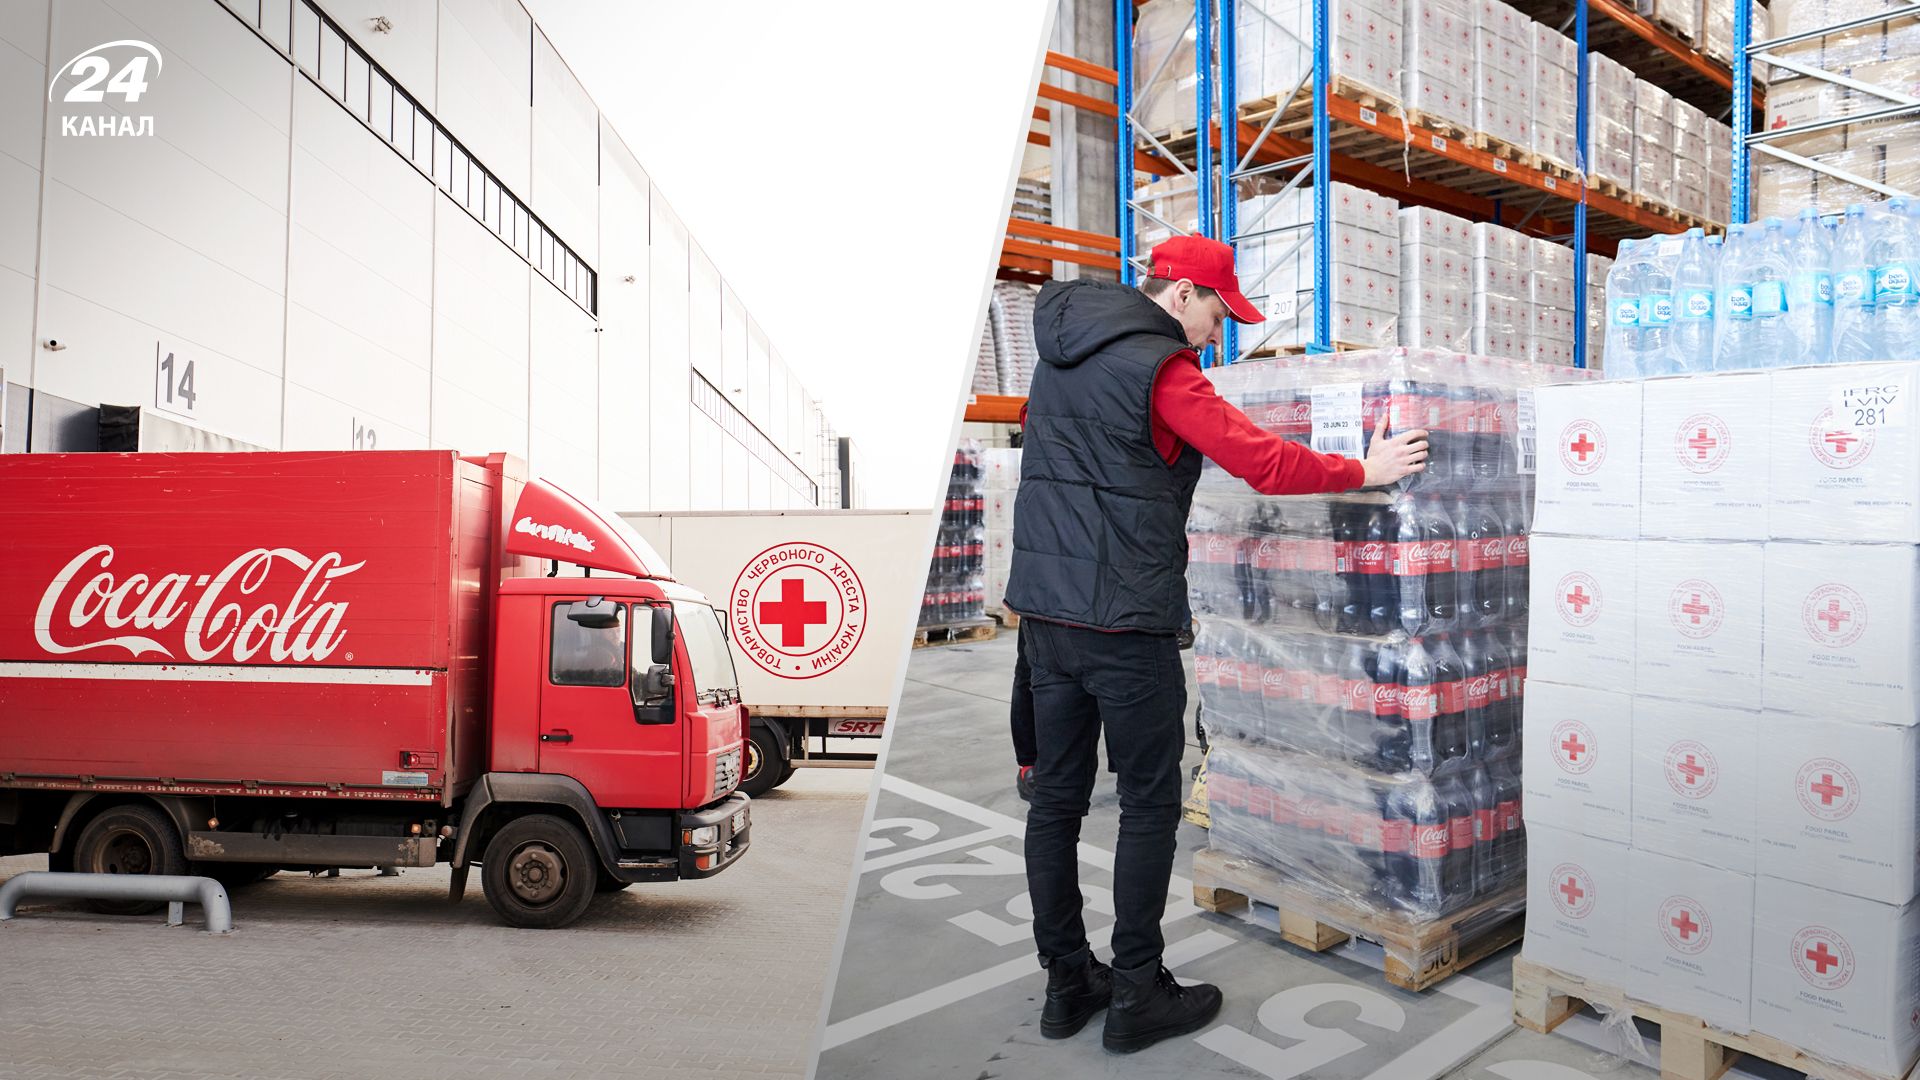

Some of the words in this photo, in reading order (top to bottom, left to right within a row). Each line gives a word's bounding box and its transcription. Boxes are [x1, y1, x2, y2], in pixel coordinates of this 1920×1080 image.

[1274, 300, 1293, 315] 207
[161, 352, 196, 410] 14
[1843, 385, 1899, 397] IFRC
[1845, 395, 1896, 407] LVIV
[1854, 408, 1886, 426] 281
[747, 549, 825, 580] ЧЕРВОНОГО
[34, 544, 367, 663] Coca-Cola
[830, 563, 860, 613] ХРЕСТА
[737, 588, 781, 670] ТОВАРИСТВО
[812, 623, 858, 670] УКРАЇНИ
[838, 719, 882, 734] SRT
[1193, 983, 1406, 1080] 5
